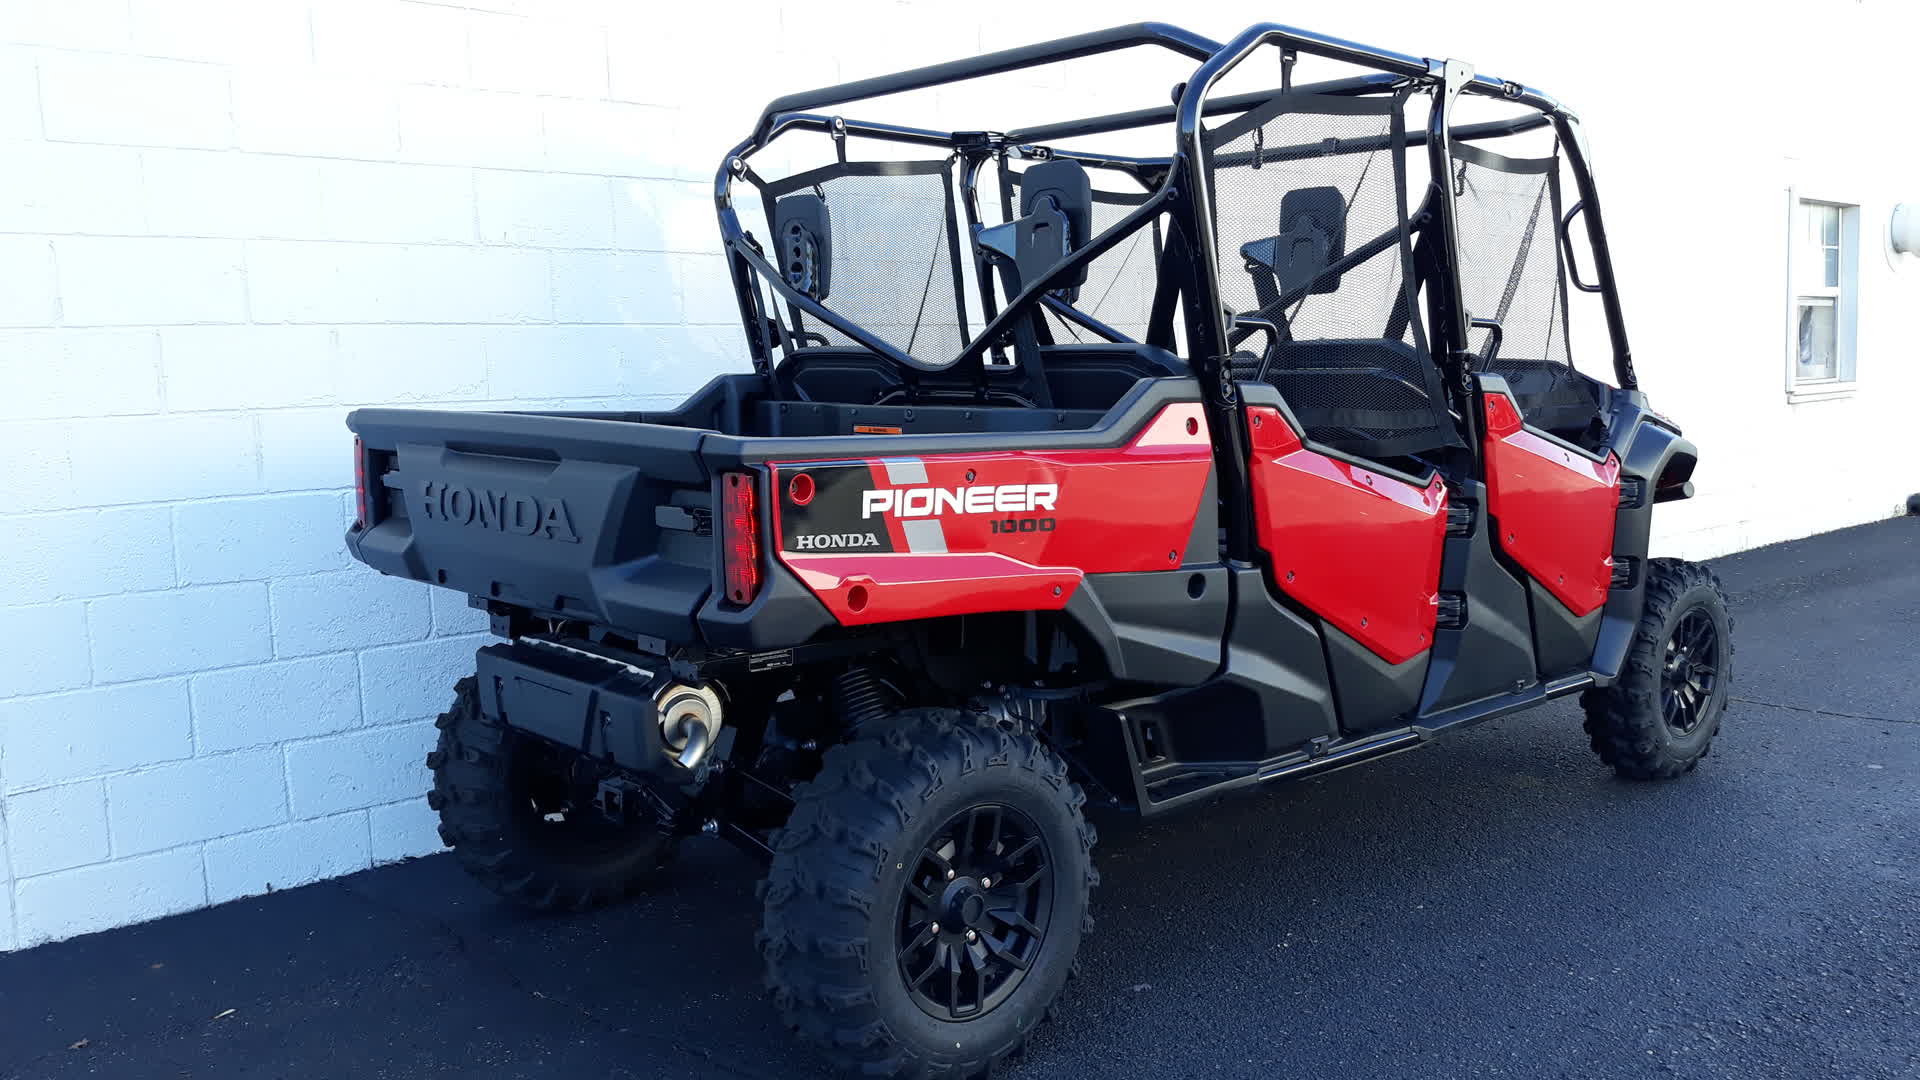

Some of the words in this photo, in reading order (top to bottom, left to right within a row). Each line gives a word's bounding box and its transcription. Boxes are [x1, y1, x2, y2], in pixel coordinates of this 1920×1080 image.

[419, 479, 581, 544] HONDA
[862, 483, 1058, 520] PIONEER
[990, 518, 1056, 534] 1000
[796, 532, 880, 550] HONDA
